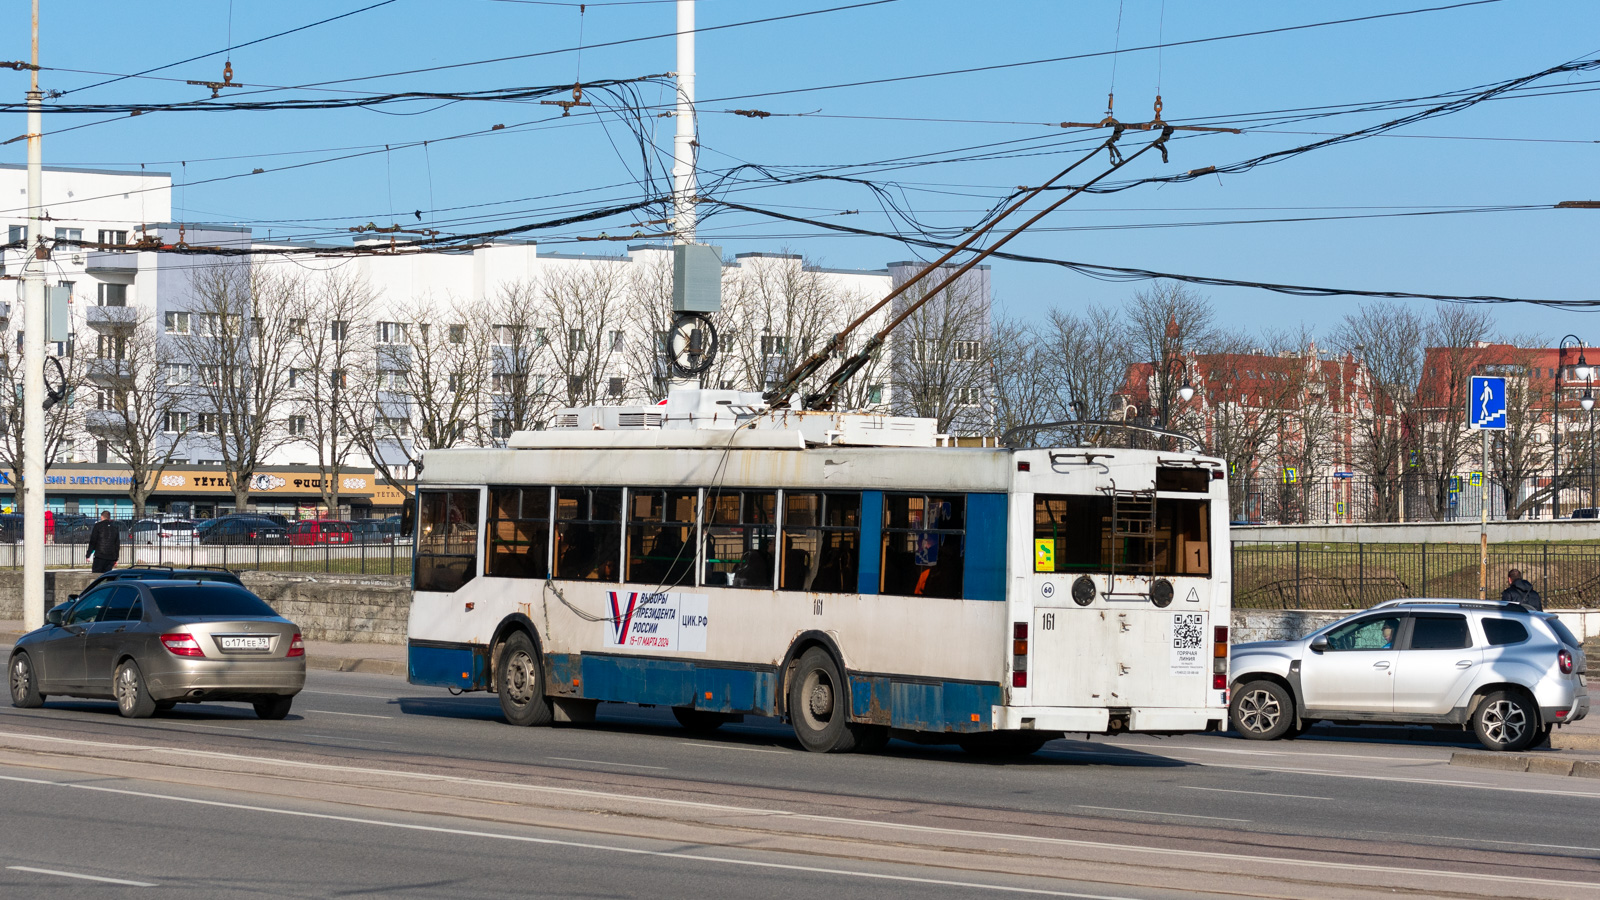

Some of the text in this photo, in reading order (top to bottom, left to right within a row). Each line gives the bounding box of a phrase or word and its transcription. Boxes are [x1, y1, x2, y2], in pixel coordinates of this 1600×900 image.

[1194, 549, 1201, 568] 1
[640, 592, 669, 604] ВЫБОРЫ
[813, 599, 823, 615] 161
[635, 608, 676, 620] ПРЕЗИДЕНТА
[682, 615, 708, 628] ЦИК.РФ
[1042, 612, 1055, 631] 161
[632, 622, 659, 634] РОССИИ
[642, 636, 658, 647] МАРТА
[657, 637, 669, 647] 2024
